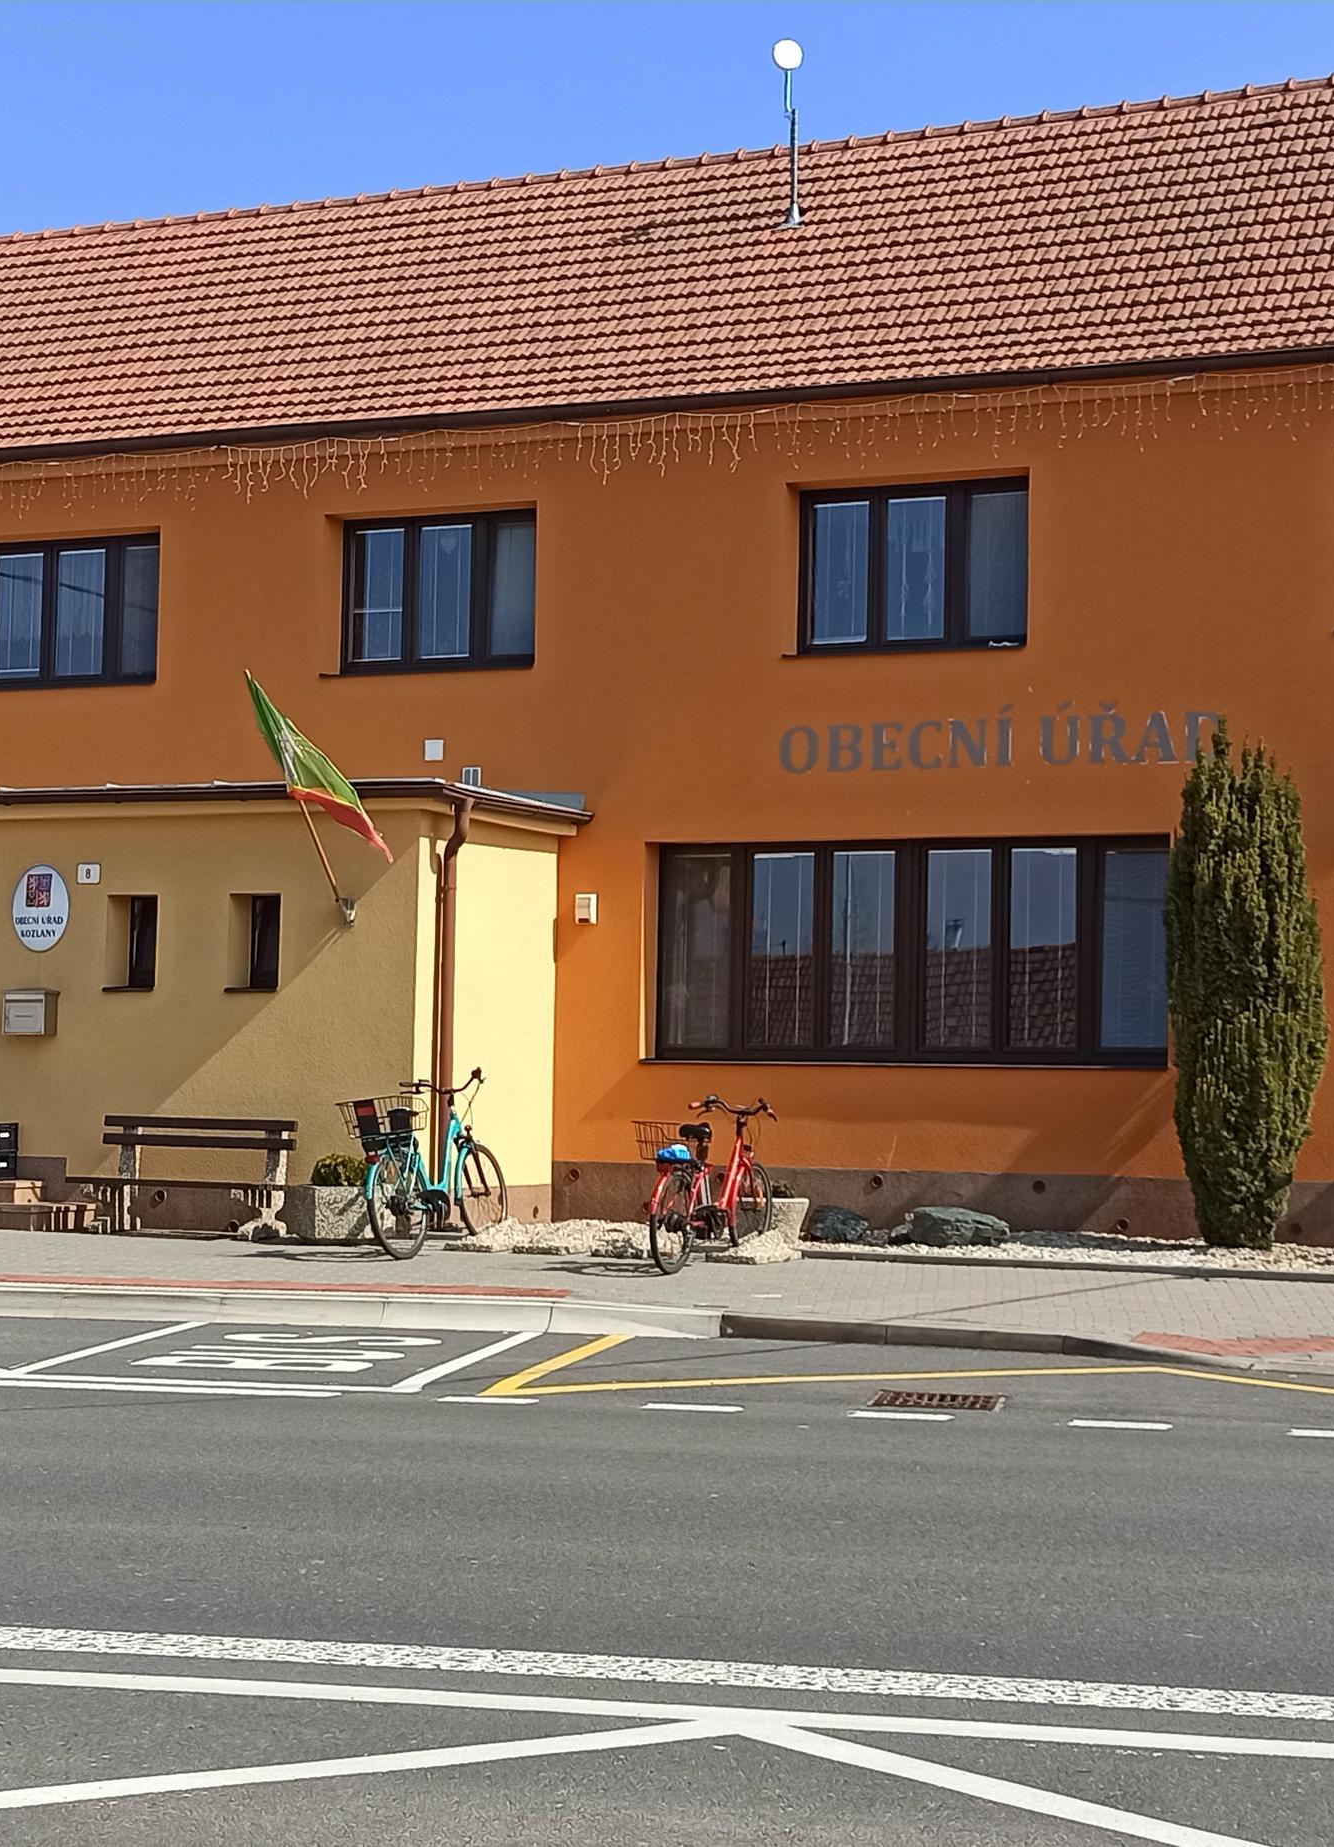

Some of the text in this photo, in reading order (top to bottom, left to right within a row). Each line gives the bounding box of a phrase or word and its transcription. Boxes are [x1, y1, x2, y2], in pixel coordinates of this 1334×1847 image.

[778, 703, 1013, 775] OBECNÍ
[85, 867, 92, 880] 8
[14, 914, 40, 925] OBECNÍ
[129, 1331, 444, 1373] BUS
